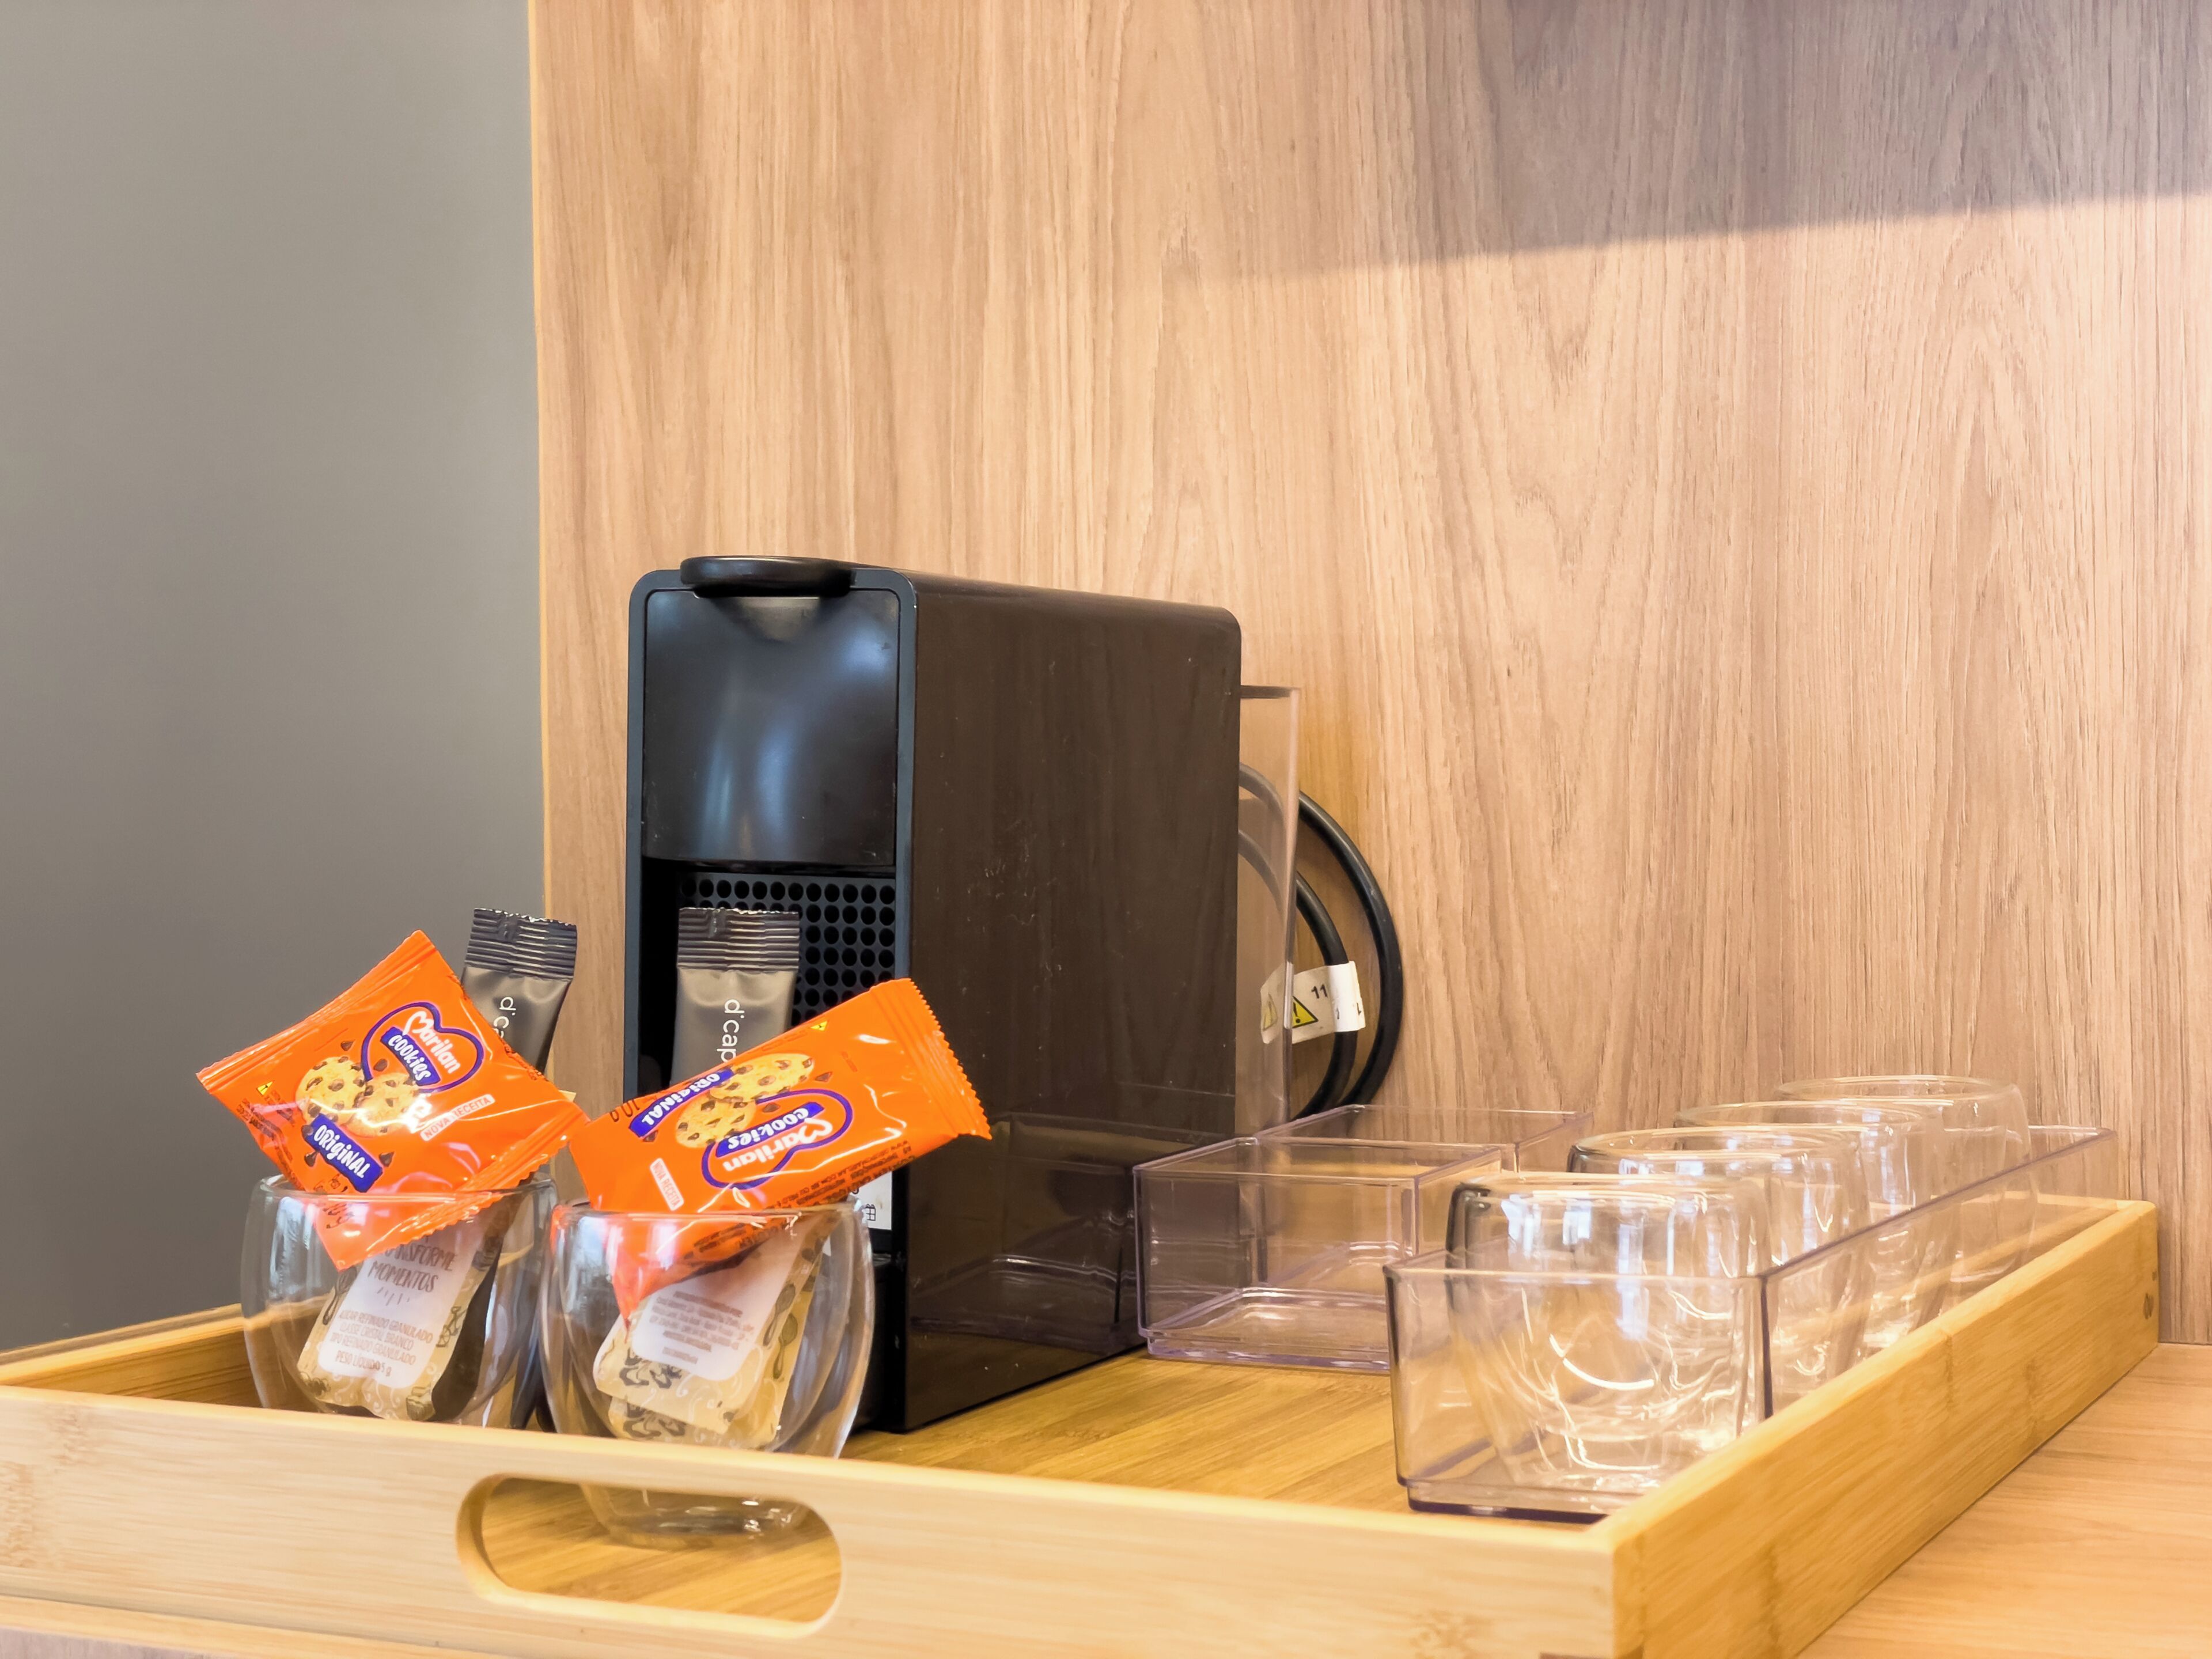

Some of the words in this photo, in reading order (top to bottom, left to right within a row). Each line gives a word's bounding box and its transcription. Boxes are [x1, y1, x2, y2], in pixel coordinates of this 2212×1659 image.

[1311, 984, 1328, 999] 11
[388, 1034, 431, 1081] cookies
[402, 1010, 461, 1074] Marilan
[423, 1118, 450, 1138] NOVA
[722, 1118, 834, 1172] Marilan
[727, 1107, 809, 1150] cookies
[653, 1161, 666, 1180] NOVA
[661, 1178, 681, 1208] RECEITA
[368, 1260, 438, 1293] MOMENTOS
[384, 1331, 415, 1351] BRANCO
[335, 1350, 353, 1365] PESO
[385, 1366, 392, 1377] g
